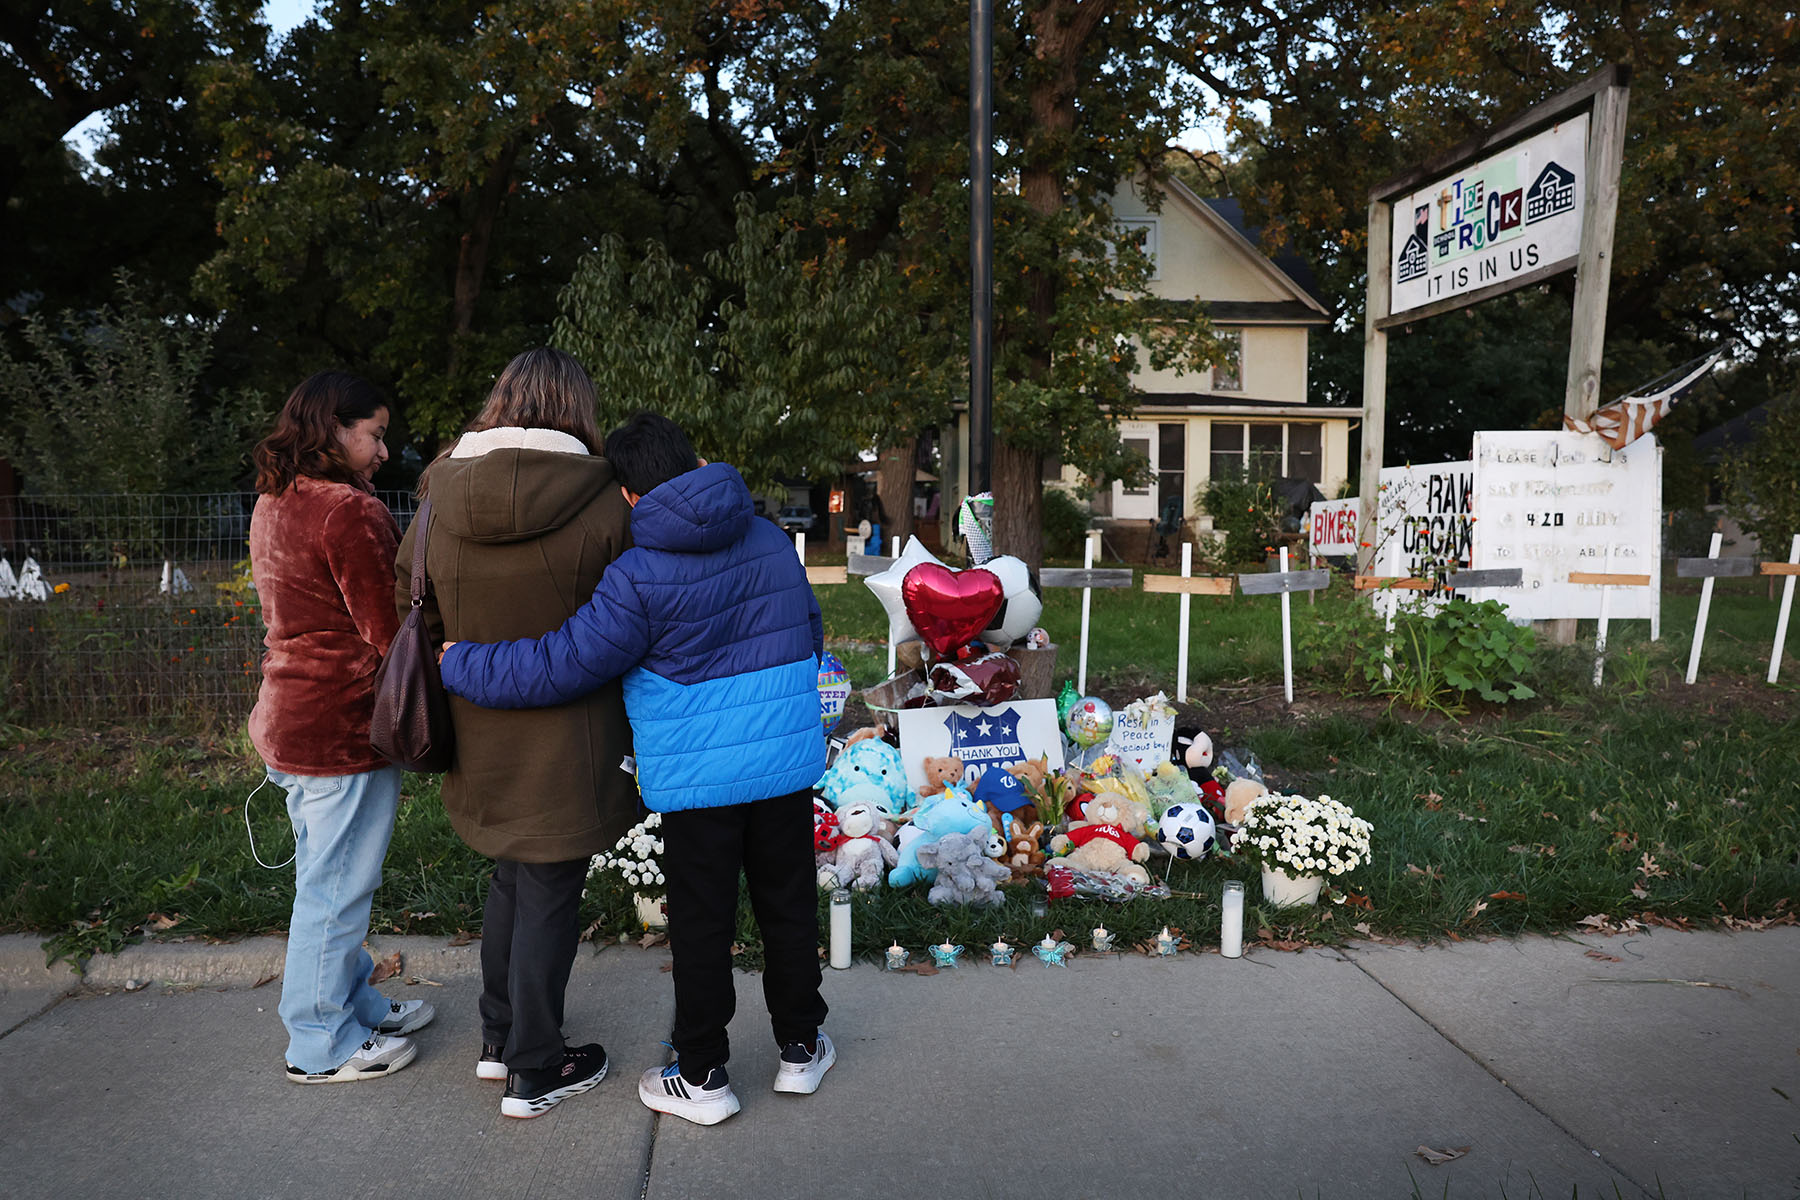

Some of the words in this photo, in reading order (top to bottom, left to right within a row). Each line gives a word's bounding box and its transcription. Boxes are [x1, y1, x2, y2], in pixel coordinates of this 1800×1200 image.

[1459, 190, 1521, 251] ROCK
[1427, 275, 1442, 298] IT
[1451, 267, 1469, 290] IS
[1480, 256, 1497, 281] IN
[1510, 243, 1540, 272] US
[1427, 472, 1474, 513] RAW
[1314, 509, 1357, 544] BIKES
[953, 748, 993, 760] THANK
[996, 745, 1018, 757] YOU
